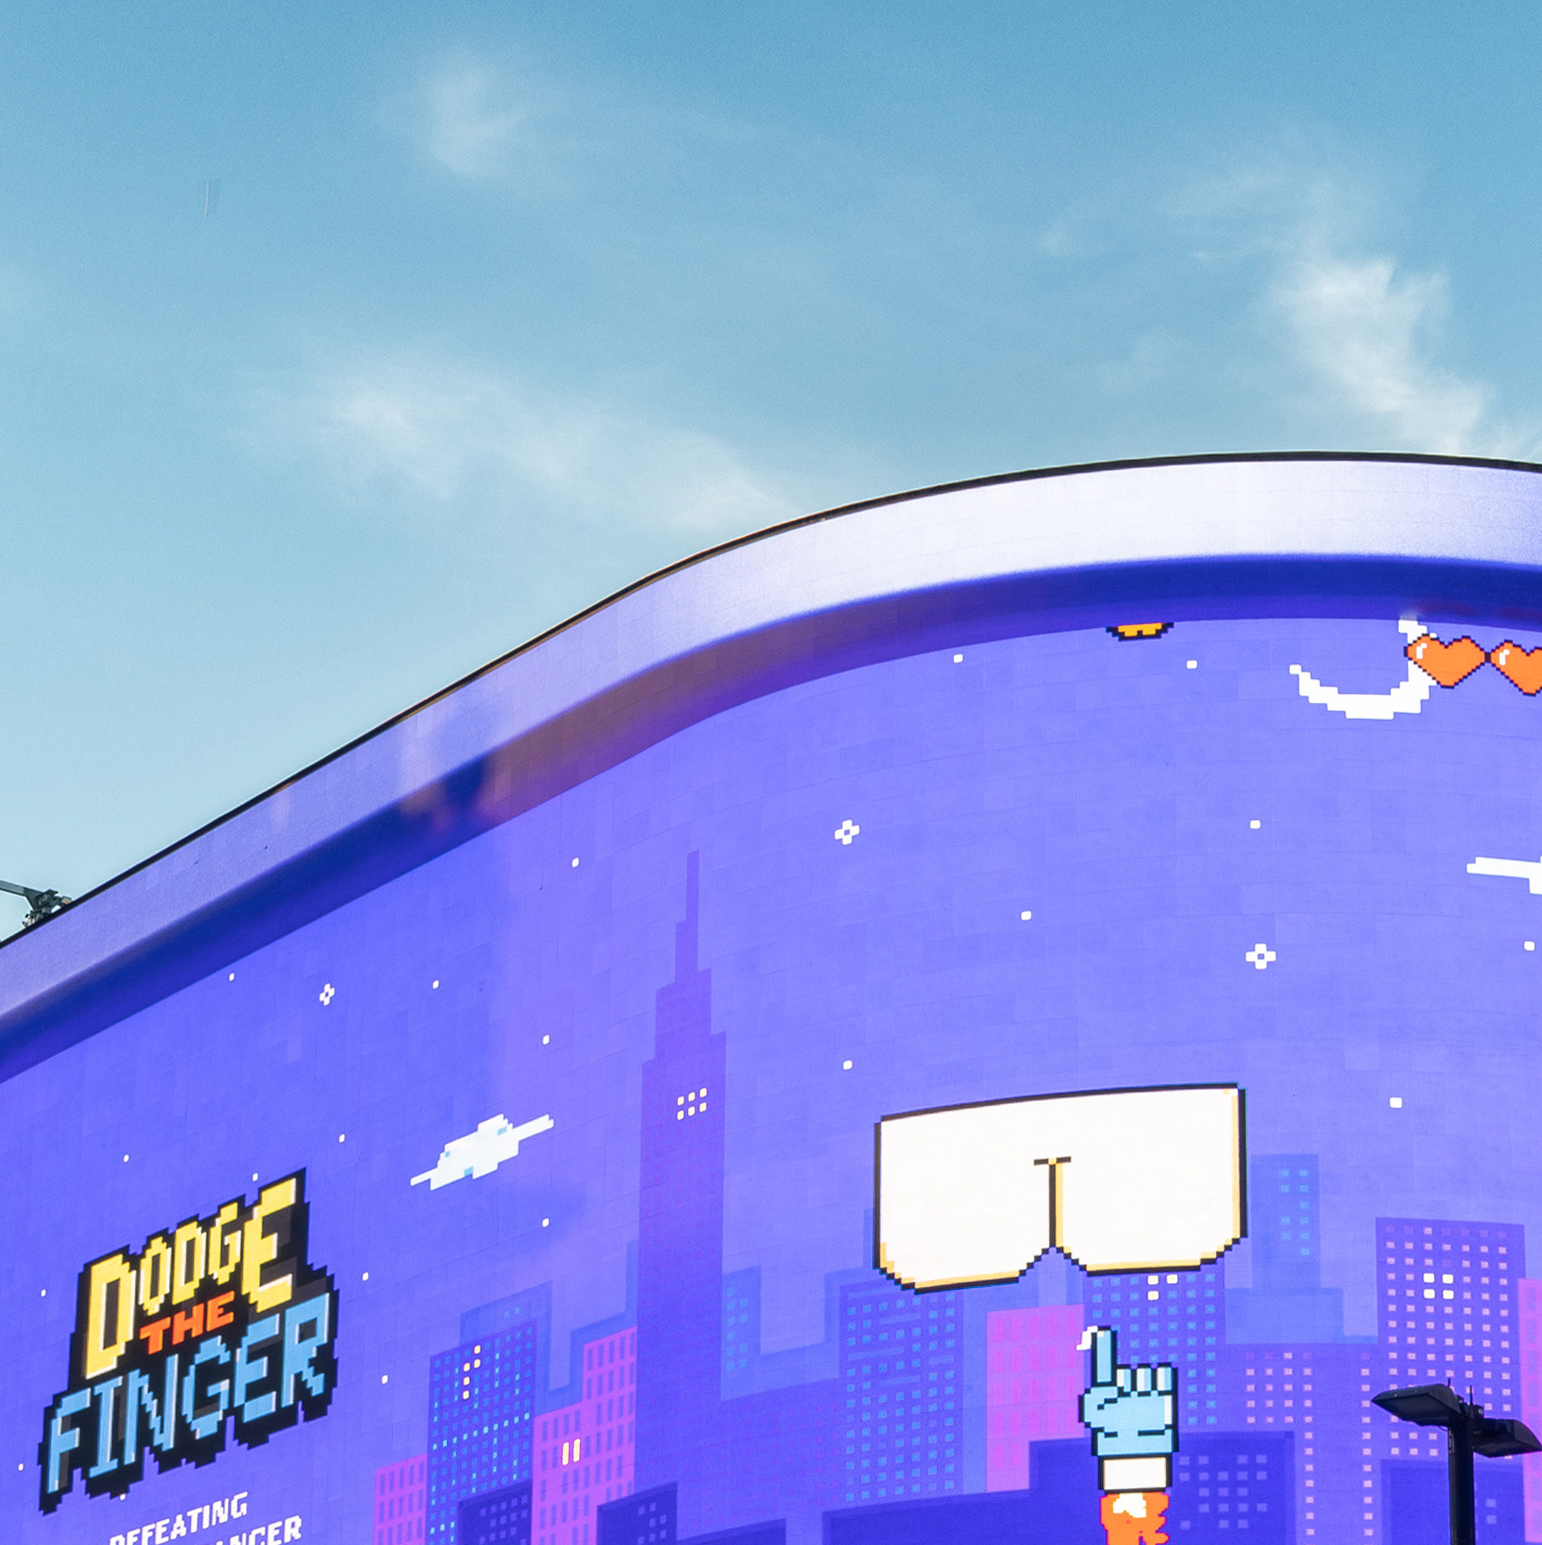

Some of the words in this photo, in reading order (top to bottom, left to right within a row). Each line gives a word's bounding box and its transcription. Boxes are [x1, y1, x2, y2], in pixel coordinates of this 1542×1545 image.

[85, 1178, 296, 1380] DODGE
[139, 1291, 234, 1354] THE
[48, 1293, 330, 1493] FINGER
